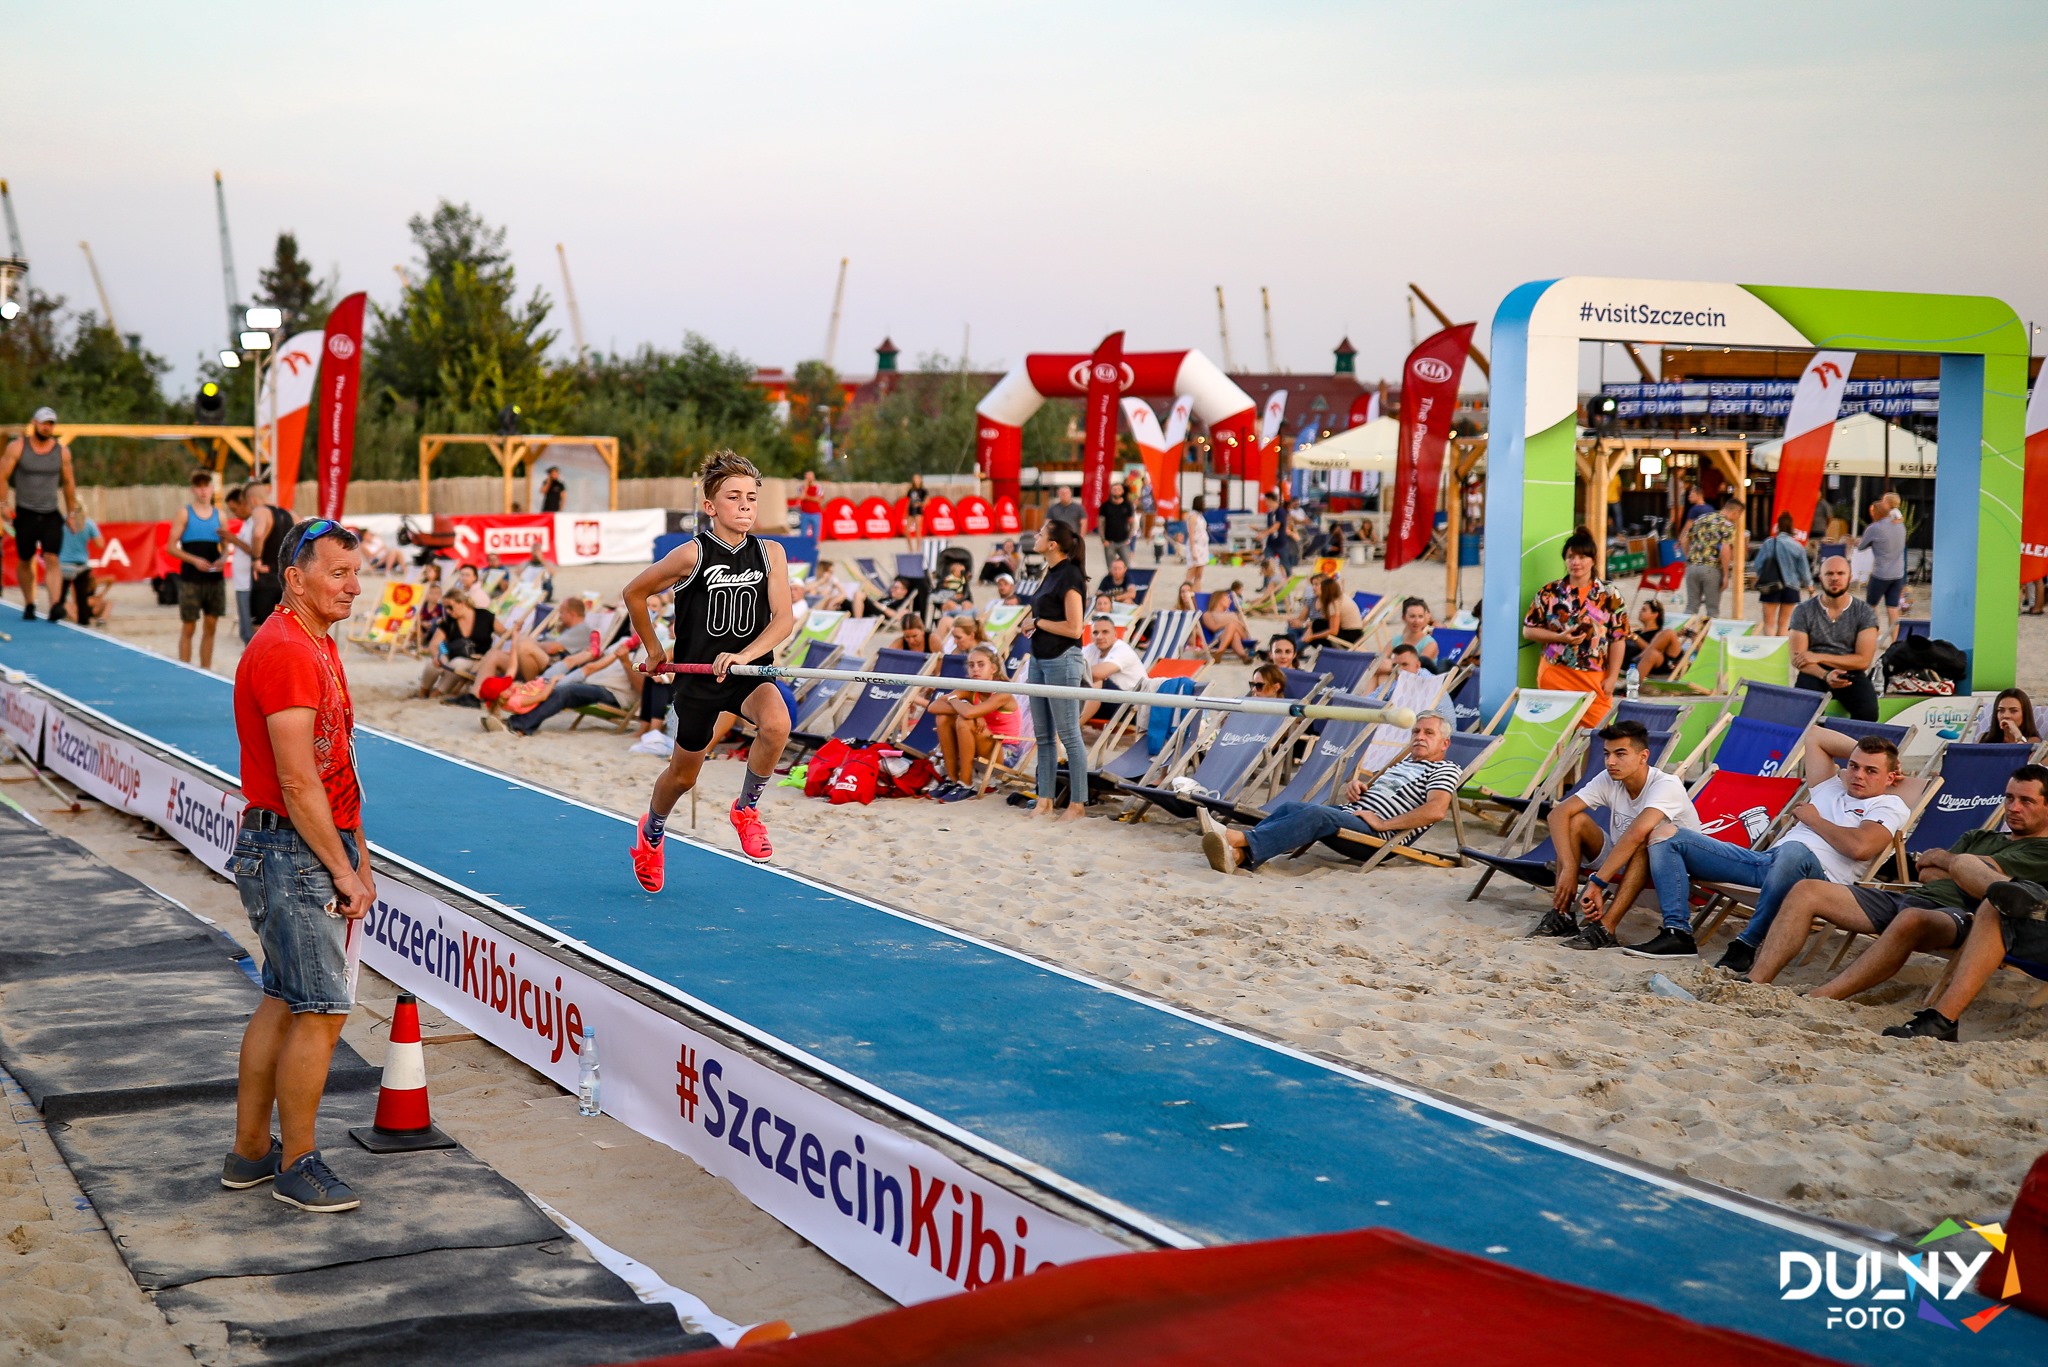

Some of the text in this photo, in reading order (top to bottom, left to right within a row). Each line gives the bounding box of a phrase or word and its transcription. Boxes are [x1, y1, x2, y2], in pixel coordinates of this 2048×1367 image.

[1579, 302, 1726, 327] #visitSzczecin
[1418, 360, 1447, 379] KIA
[1418, 397, 1434, 422] The
[490, 533, 543, 548] ORLEN
[703, 564, 764, 590] Thunder
[707, 585, 758, 637] 00
[1938, 793, 1971, 811] Wyspa
[166, 776, 244, 855] #Szczecin
[364, 899, 583, 1063] SzczecinKibicuje
[676, 1043, 1058, 1291] #SzczecinKibi
